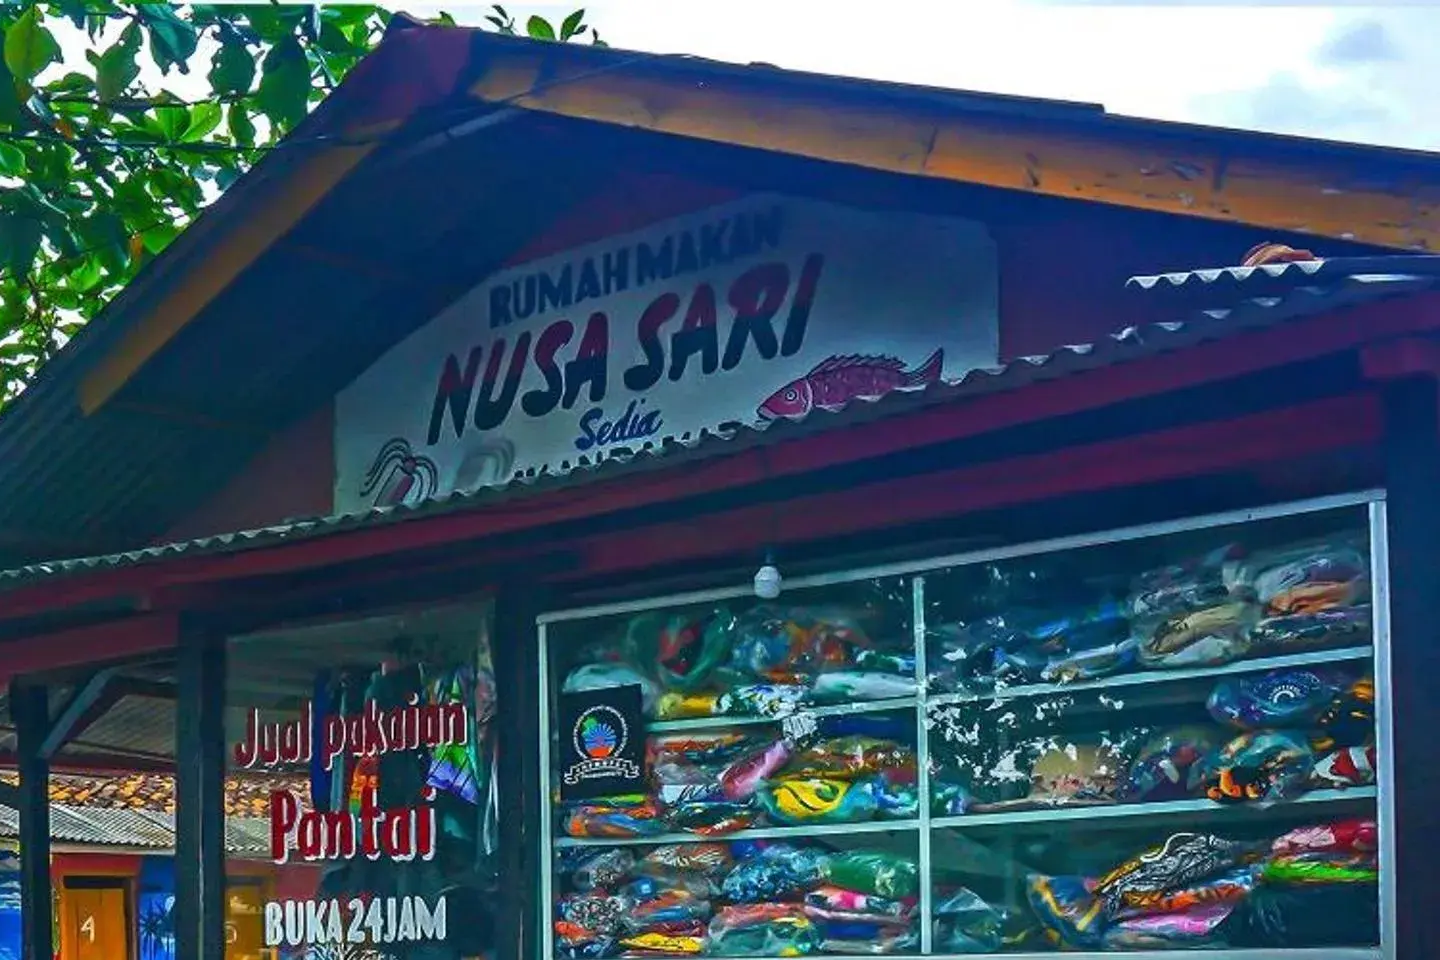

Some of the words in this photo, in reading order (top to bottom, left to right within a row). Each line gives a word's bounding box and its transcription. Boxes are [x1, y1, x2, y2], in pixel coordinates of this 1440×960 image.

[490, 246, 628, 328] RUMAH
[636, 205, 785, 284] MAKAN
[427, 311, 610, 446] NUSA
[624, 253, 825, 392] SARI
[573, 398, 663, 451] Sedia
[234, 700, 312, 768] Jual
[323, 693, 468, 769] pakaian
[270, 787, 437, 864] Pantai
